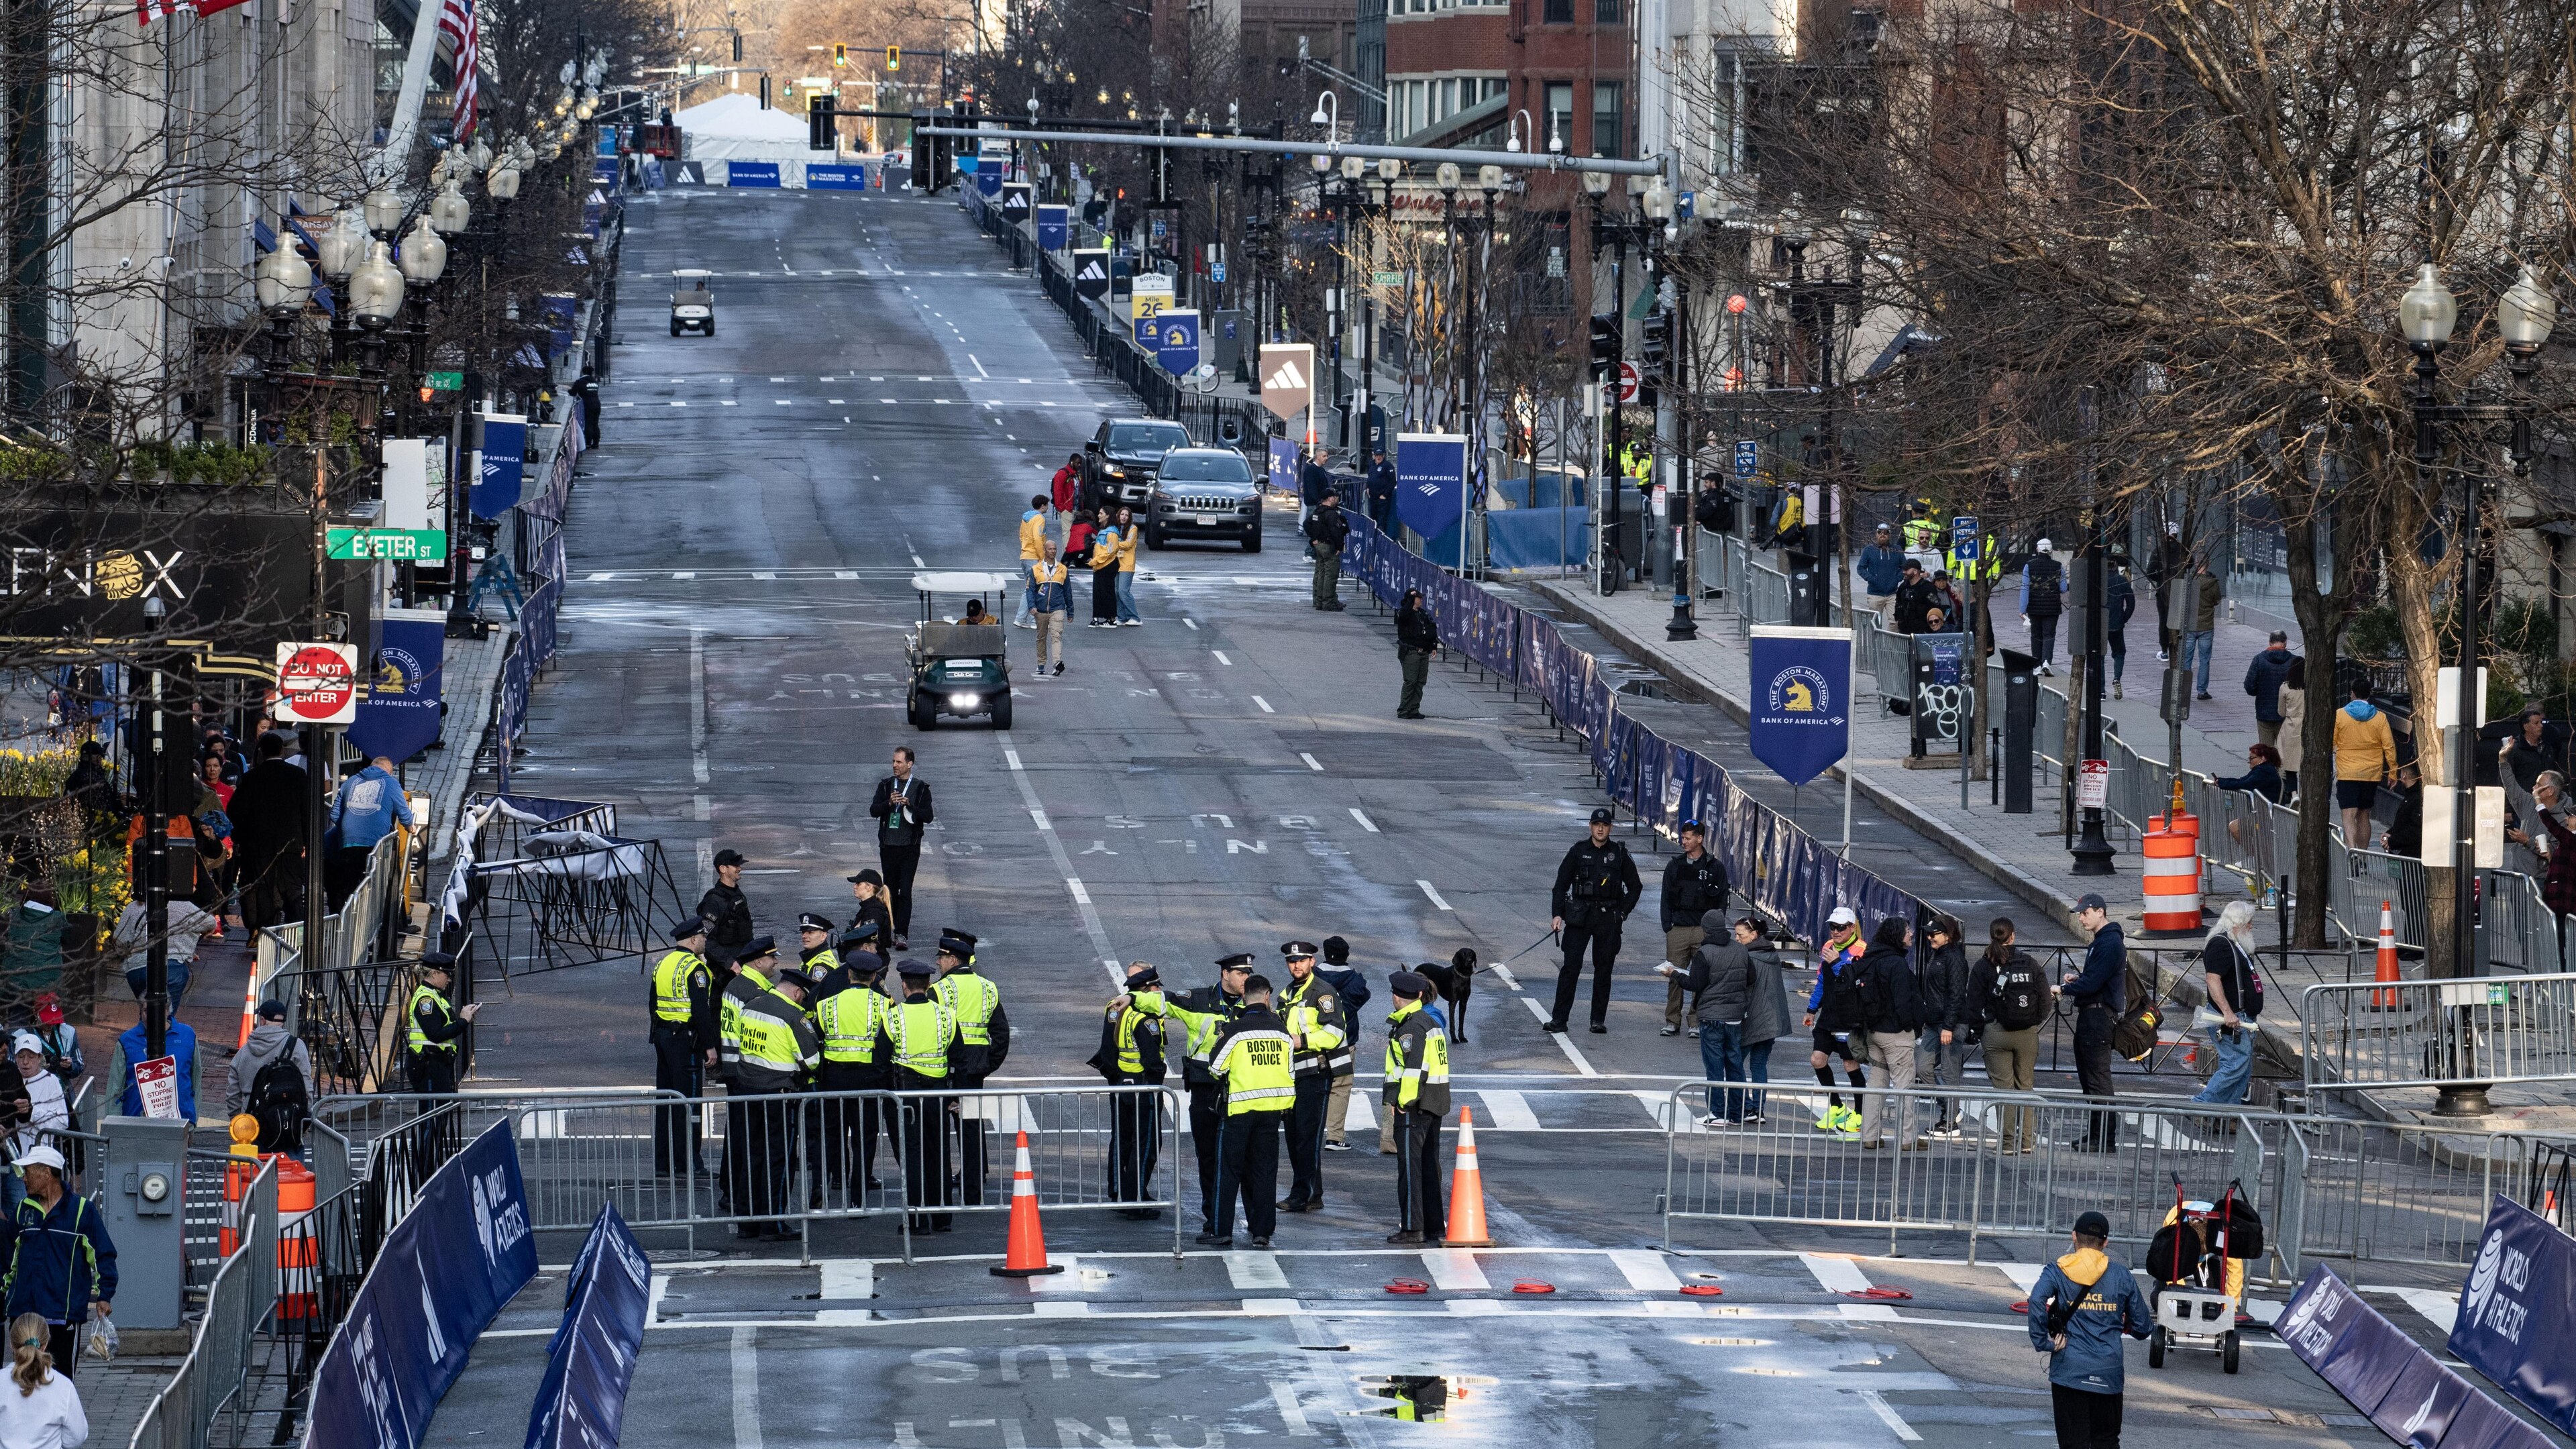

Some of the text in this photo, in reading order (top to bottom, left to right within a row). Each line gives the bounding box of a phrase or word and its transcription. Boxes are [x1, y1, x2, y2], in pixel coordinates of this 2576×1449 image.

[1141, 303, 1163, 317] 26
[353, 535, 431, 557] EXETER ST
[290, 662, 343, 675] DO NOT
[397, 651, 419, 690] MARATHON
[1774, 669, 1801, 687] BOSTON
[1805, 669, 1827, 706] MARATHON
[295, 692, 337, 704] ENTER
[386, 700, 421, 708] AMERICA
[676, 960, 689, 994] POLICE
[2012, 973, 2029, 982] CST
[740, 1022, 767, 1041] Boston
[892, 1014, 902, 1050] BOSTON
[1127, 1012, 1135, 1044] OLICE
[1247, 1040, 1282, 1053] BOSTON
[1251, 1054, 1281, 1066] POLICE
[154, 1080, 166, 1089] NO
[148, 1087, 173, 1098] STOPPING
[2500, 1246, 2530, 1293] WORLD
[2084, 1293, 2102, 1301] ACE
[910, 1344, 1161, 1384] BUS
